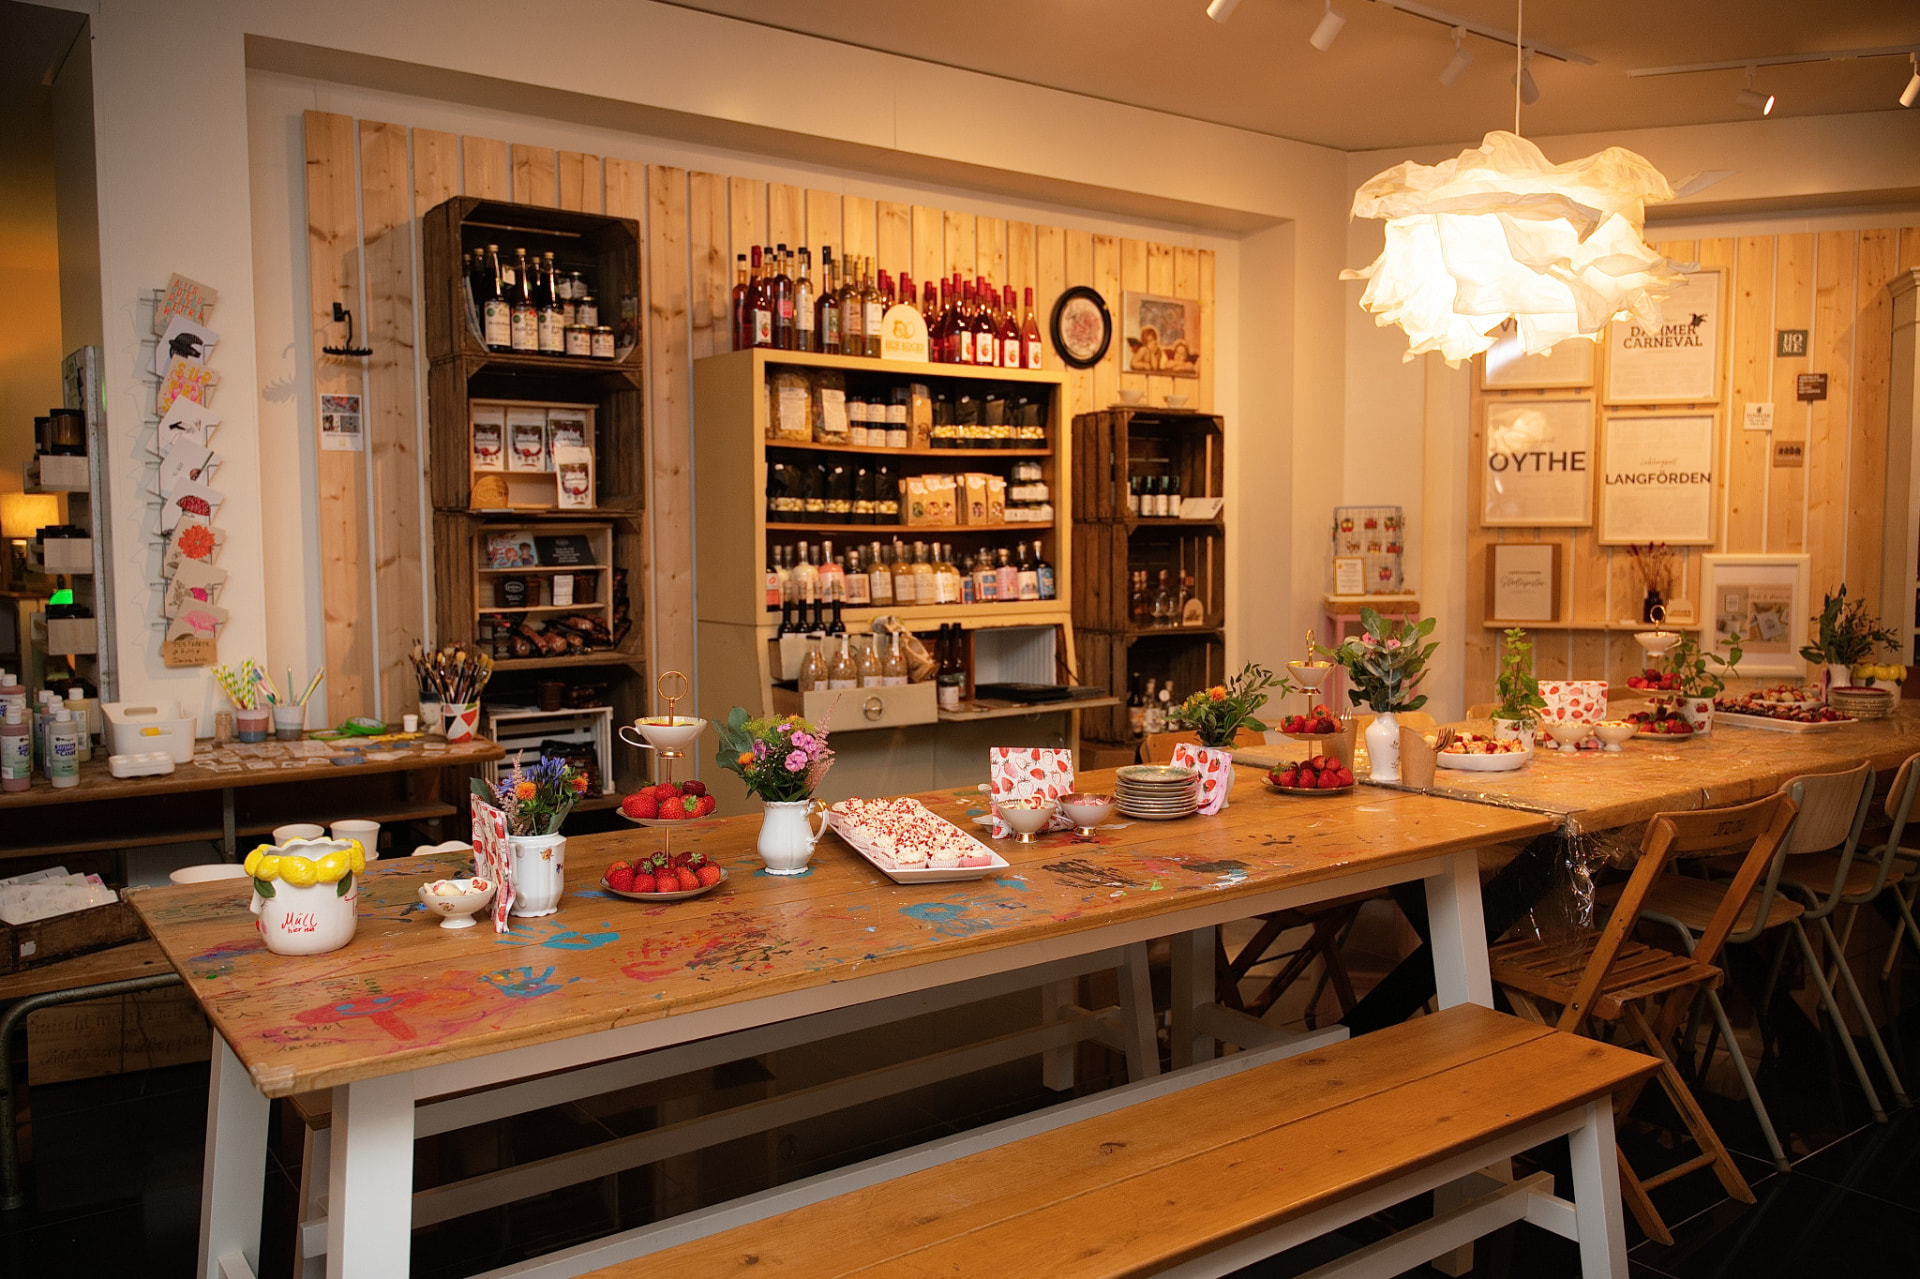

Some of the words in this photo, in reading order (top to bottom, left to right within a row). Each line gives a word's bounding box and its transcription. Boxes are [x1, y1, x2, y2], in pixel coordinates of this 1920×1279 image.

[1623, 336, 1703, 350] CARNEVAL
[1489, 451, 1586, 473] OYTHE
[1605, 470, 1711, 485] LANGFÖRDEN
[282, 912, 317, 929] Müll
